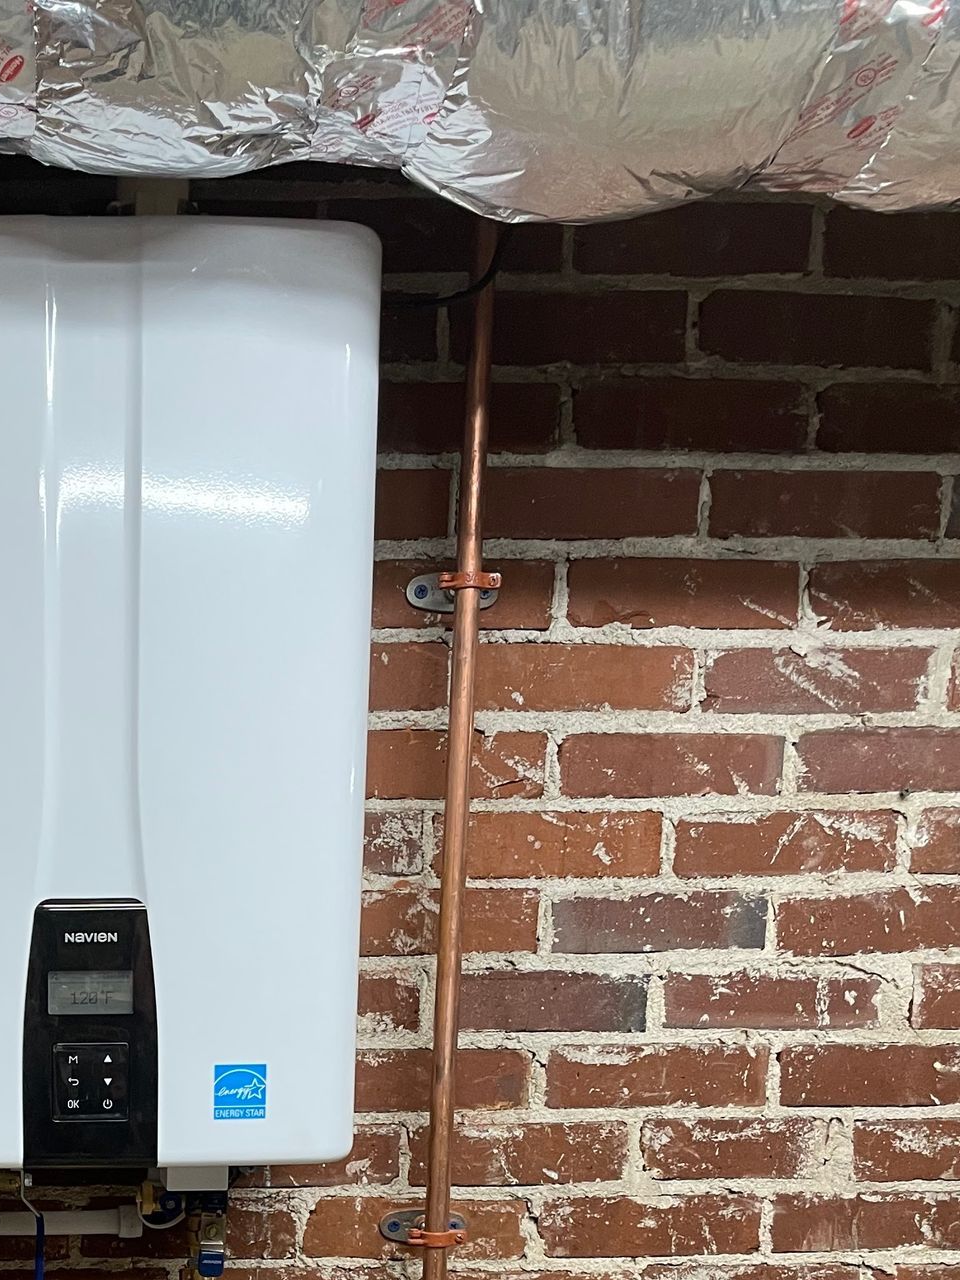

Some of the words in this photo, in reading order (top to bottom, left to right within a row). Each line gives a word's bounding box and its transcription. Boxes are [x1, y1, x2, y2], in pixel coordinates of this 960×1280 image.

[68, 1055, 78, 1064] M
[67, 1099, 80, 1109] OK
[215, 1109, 244, 1118] ENERGY
[245, 1108, 265, 1117] STAR
